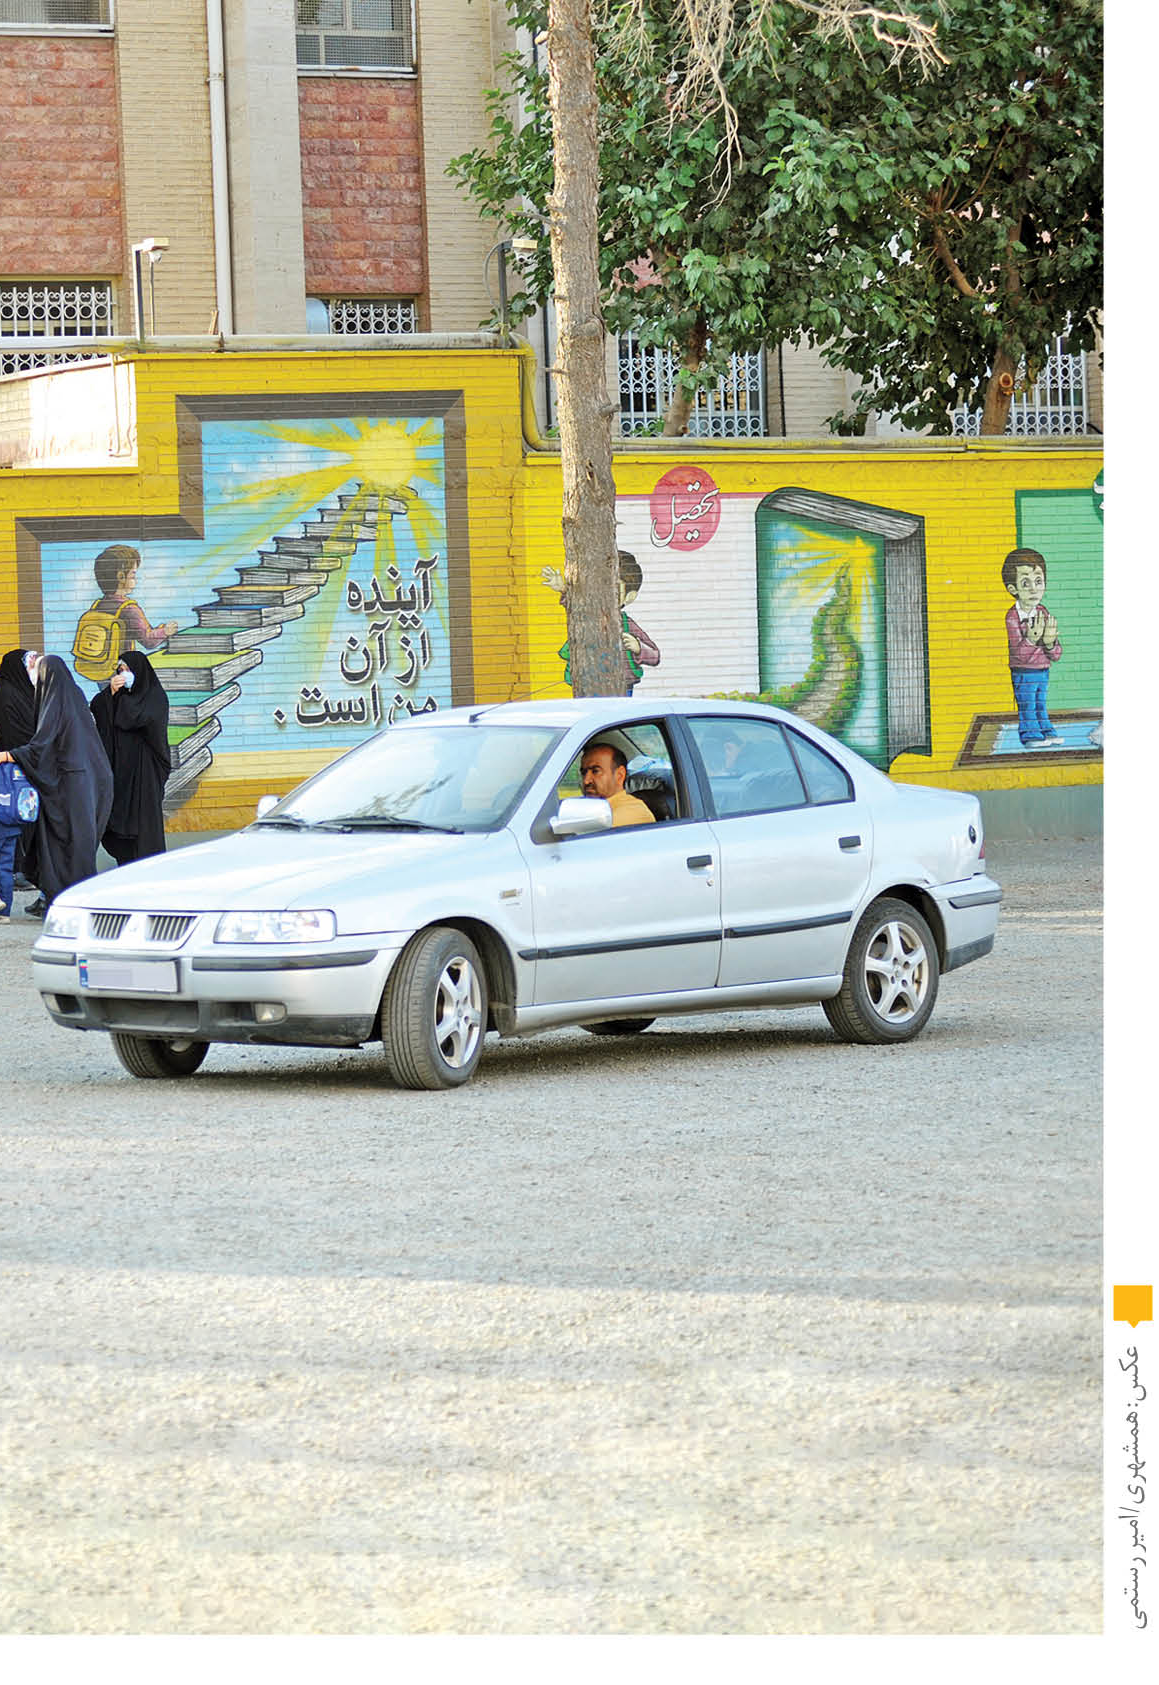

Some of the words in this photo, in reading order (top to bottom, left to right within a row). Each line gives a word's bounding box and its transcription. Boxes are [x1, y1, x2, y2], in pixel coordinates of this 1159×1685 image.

[650, 480, 721, 548] تحصیل
[346, 553, 440, 628] آینده
[340, 618, 392, 684] آن
[393, 632, 430, 686] از
